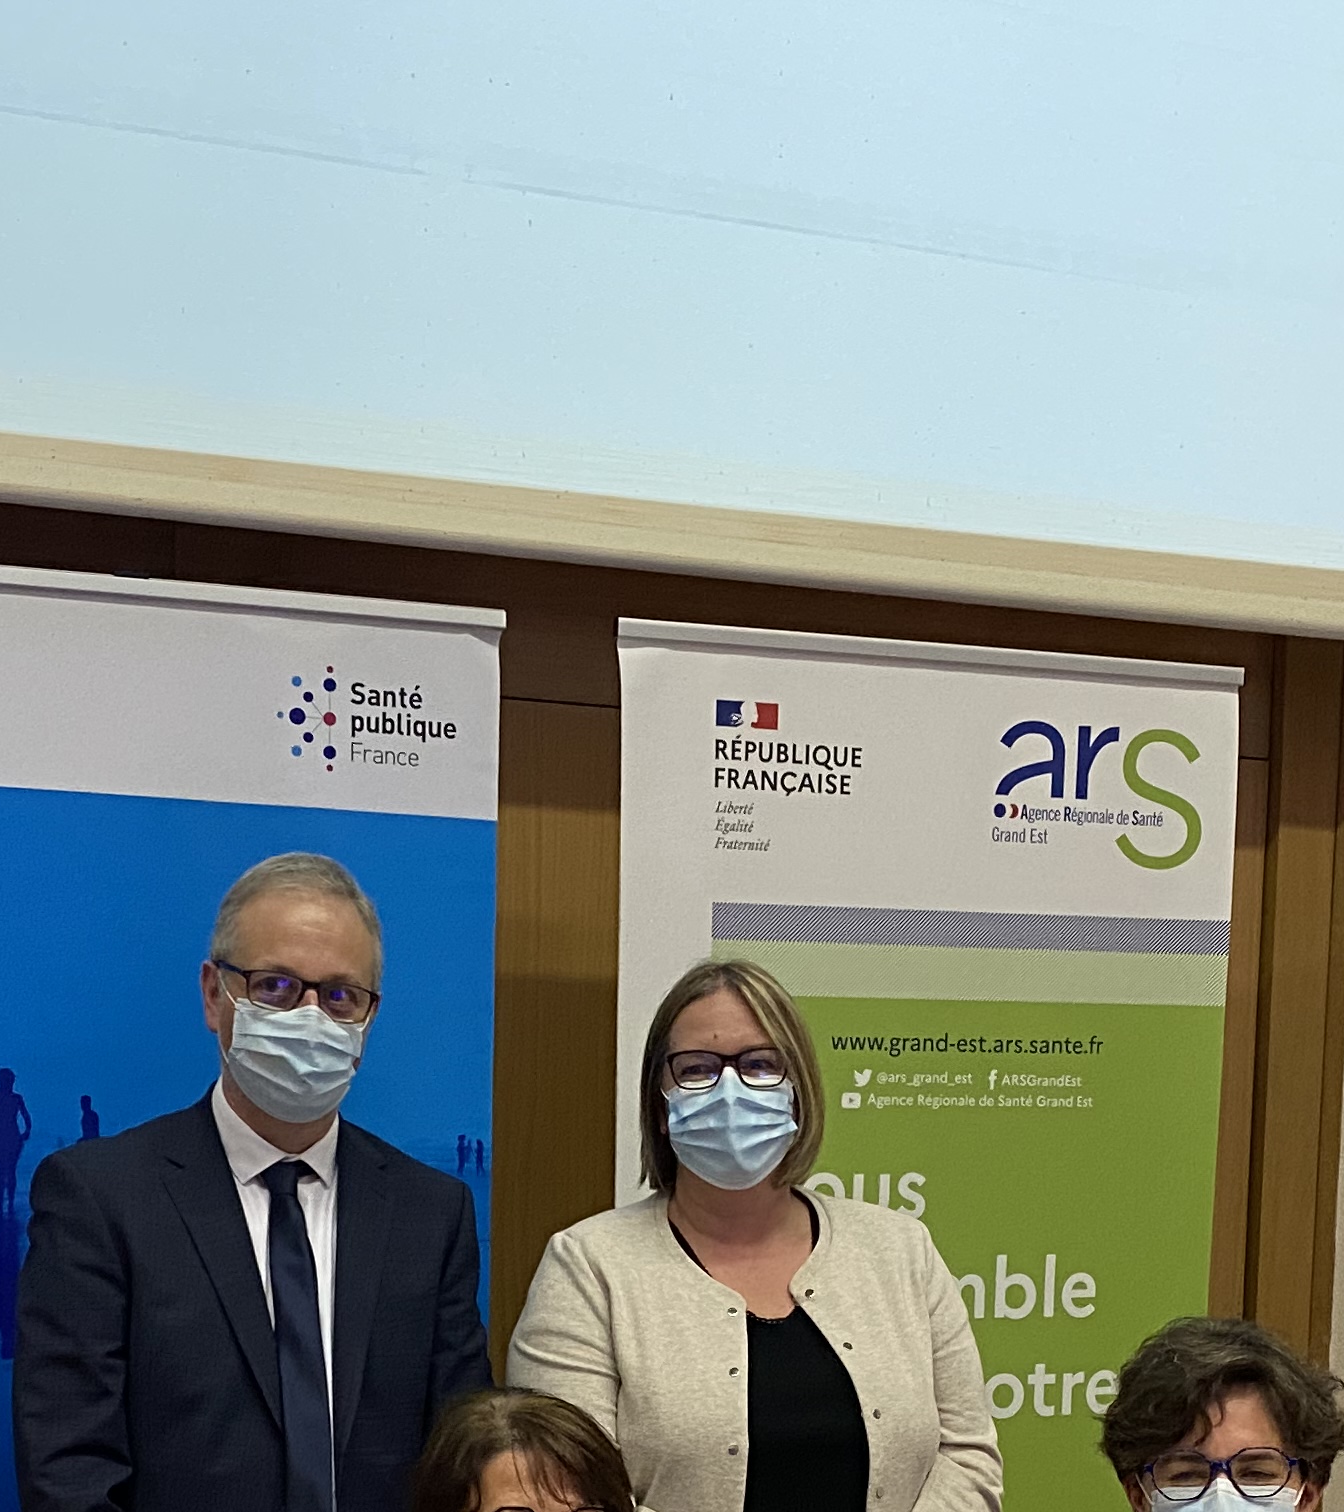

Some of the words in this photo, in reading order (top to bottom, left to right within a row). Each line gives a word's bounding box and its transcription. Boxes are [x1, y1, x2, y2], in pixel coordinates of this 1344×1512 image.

[350, 682, 423, 709] Santé
[350, 712, 458, 743] publique
[350, 741, 420, 767] France
[714, 734, 863, 771] RÉPUBLIQUE
[714, 767, 851, 797] FRANÇAISE
[714, 800, 754, 815] Liberté
[1020, 804, 1061, 823] Agence
[1063, 806, 1114, 826] Régionale
[1116, 809, 1129, 825] de
[1131, 810, 1164, 827] Santé
[714, 816, 754, 835] Égalité
[991, 826, 1026, 843] Grand
[1030, 828, 1048, 845] Est
[714, 836, 771, 852] Fraternité
[831, 1033, 1104, 1057] www.grand-est.ars.sante.fr
[876, 1070, 973, 1088] @ars_grand_est
[1001, 1073, 1082, 1088] ARSGrandEst
[867, 1093, 913, 1109] Agence
[917, 1093, 976, 1110] Régionale
[979, 1094, 995, 1107] de
[997, 1094, 1033, 1107] Santé
[1036, 1095, 1073, 1108] Grand
[1077, 1096, 1093, 1109] Est
[804, 1172, 927, 1220] ous
[984, 1364, 1119, 1419] otre
